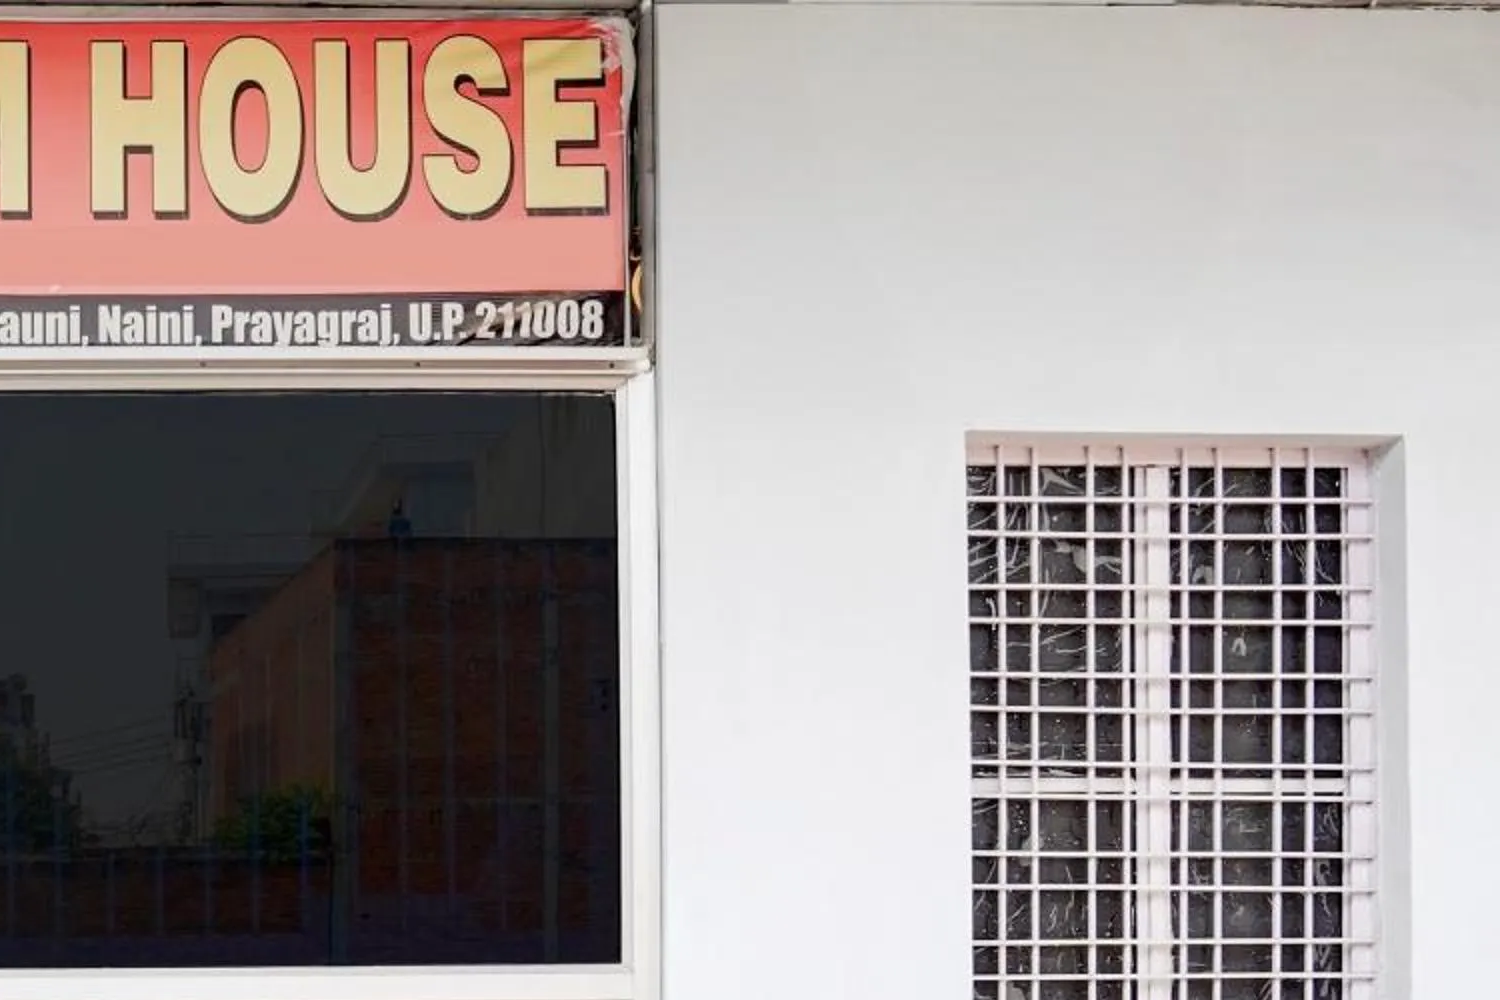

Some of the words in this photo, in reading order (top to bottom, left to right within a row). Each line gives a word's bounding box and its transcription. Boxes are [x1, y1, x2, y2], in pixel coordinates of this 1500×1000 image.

[88, 35, 610, 223] HOUSE
[97, 303, 202, 347] Naini,
[211, 303, 401, 348] Prayagraj,
[409, 303, 467, 341] U.P.
[475, 299, 604, 340] 211008
